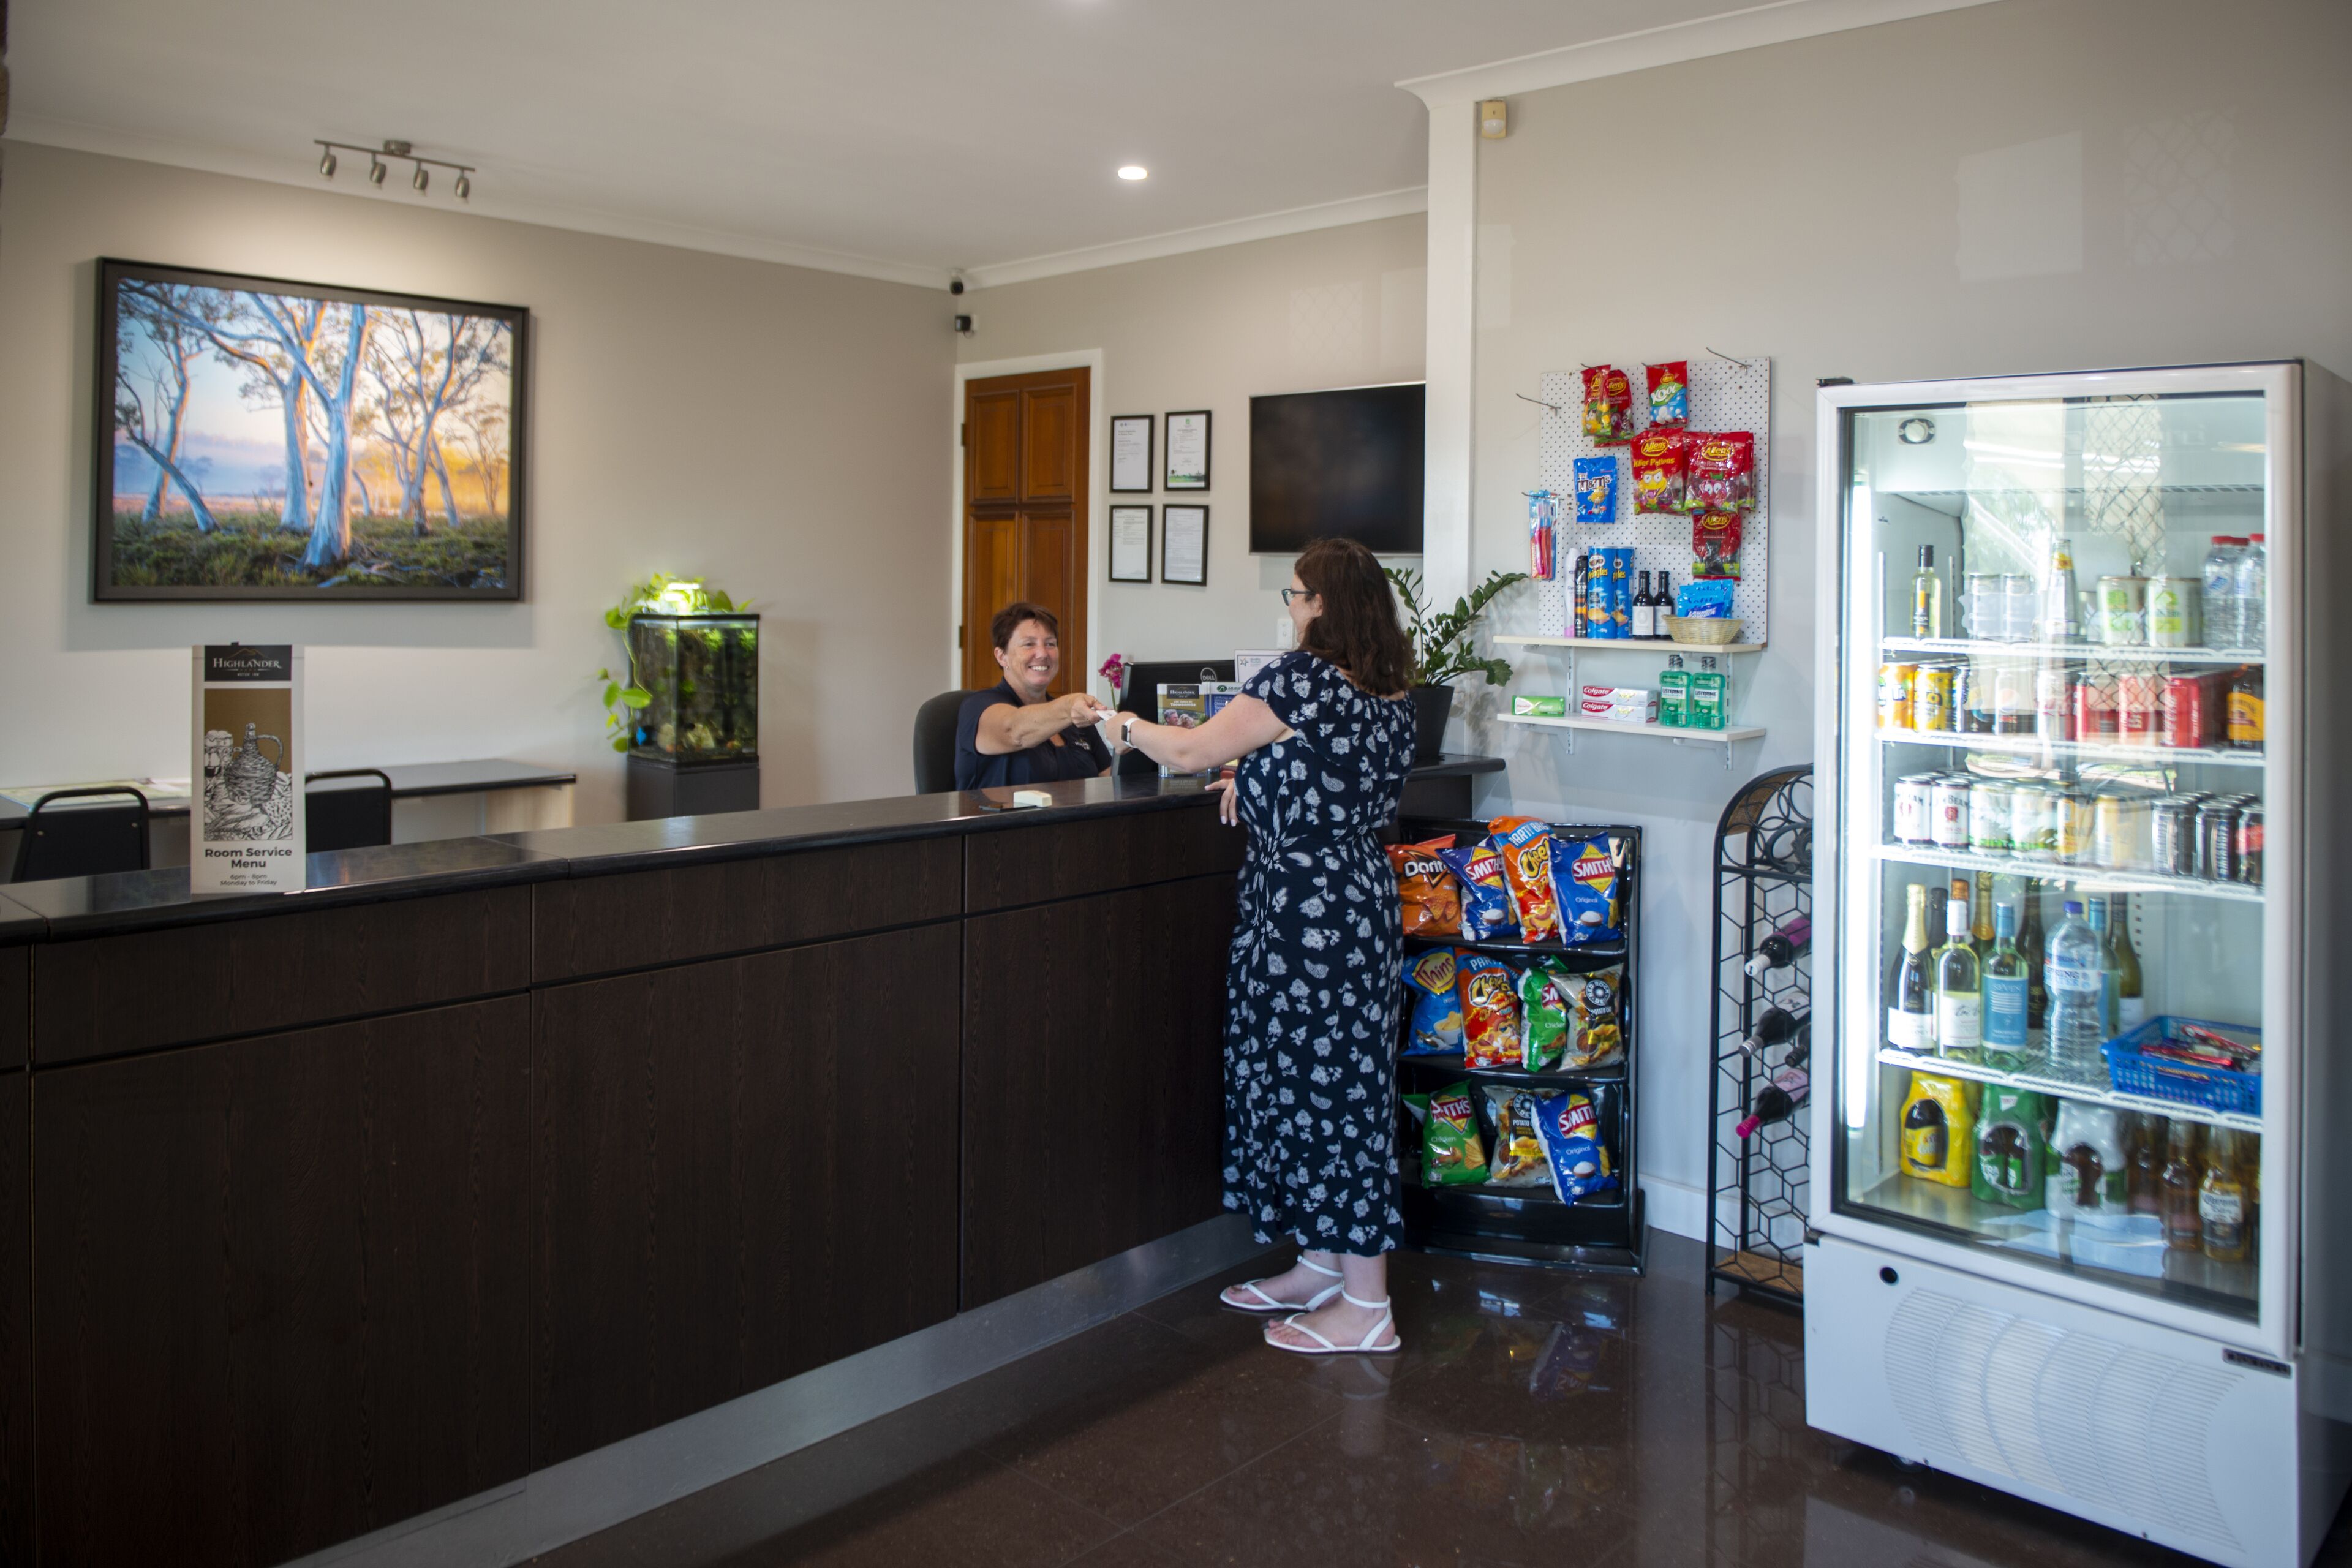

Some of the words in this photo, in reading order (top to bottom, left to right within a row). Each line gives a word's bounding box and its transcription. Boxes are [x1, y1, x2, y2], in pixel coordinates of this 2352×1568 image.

[1643, 440, 1667, 452] Allen's
[1705, 446, 1731, 456] Allen's
[1705, 514, 1728, 524] Allen's
[1588, 568, 1608, 581] Pringles
[213, 657, 282, 669] HIGHLANDER
[1583, 702, 1608, 710] Colgate
[1508, 825, 1532, 846] PARTY
[205, 848, 243, 858] Room
[246, 847, 292, 857] Service
[231, 859, 266, 869] Menu
[1520, 839, 1548, 879] Cheet
[1404, 859, 1450, 877] Dorit
[1415, 957, 1455, 988] Thins
[1595, 981, 1611, 995] ROCK
[1431, 1098, 1471, 1117] SITH'S
[1559, 1105, 1596, 1132] SMITH
[1566, 1145, 1591, 1155] Original
